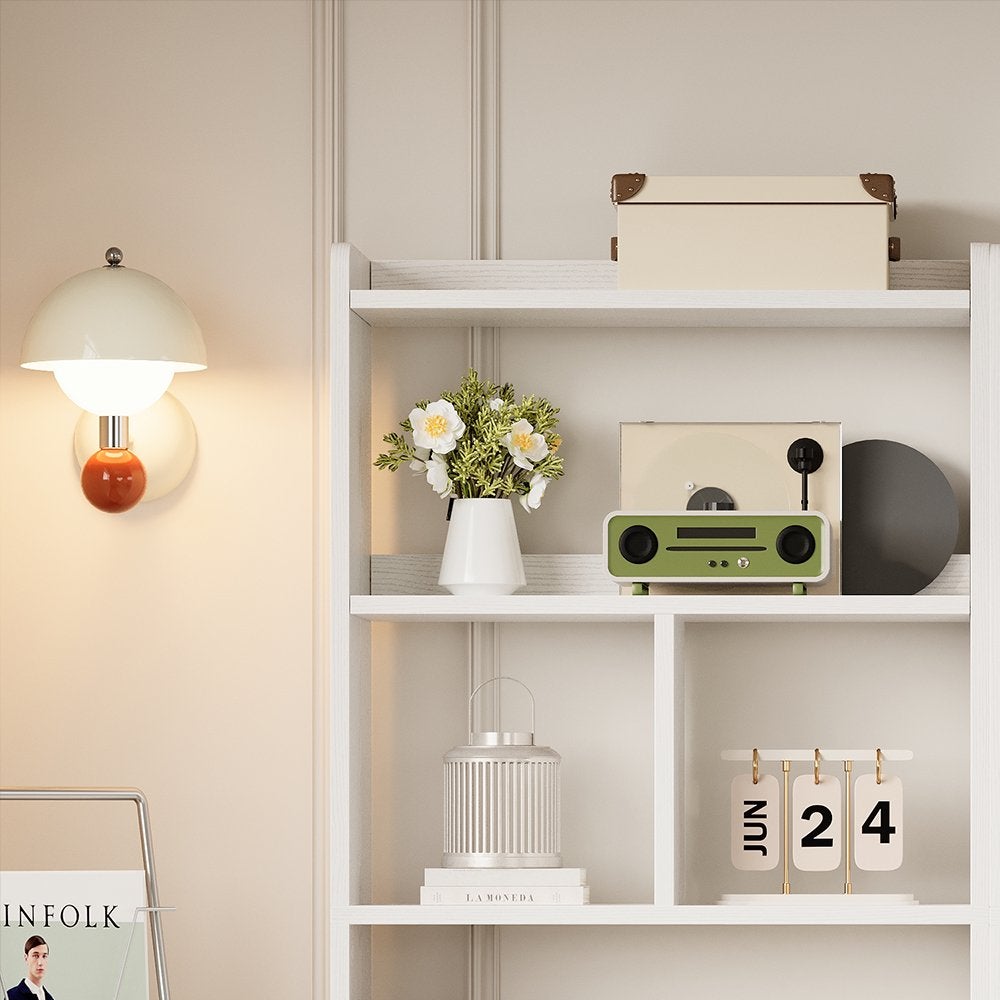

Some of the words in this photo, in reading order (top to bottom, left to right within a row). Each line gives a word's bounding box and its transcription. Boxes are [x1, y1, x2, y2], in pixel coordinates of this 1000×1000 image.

[744, 800, 767, 856] JUN
[801, 804, 833, 847] 2
[862, 801, 896, 844] 4
[466, 894, 482, 902] LA
[488, 894, 534, 902] MONEDA
[4, 904, 120, 928] INFOLK
